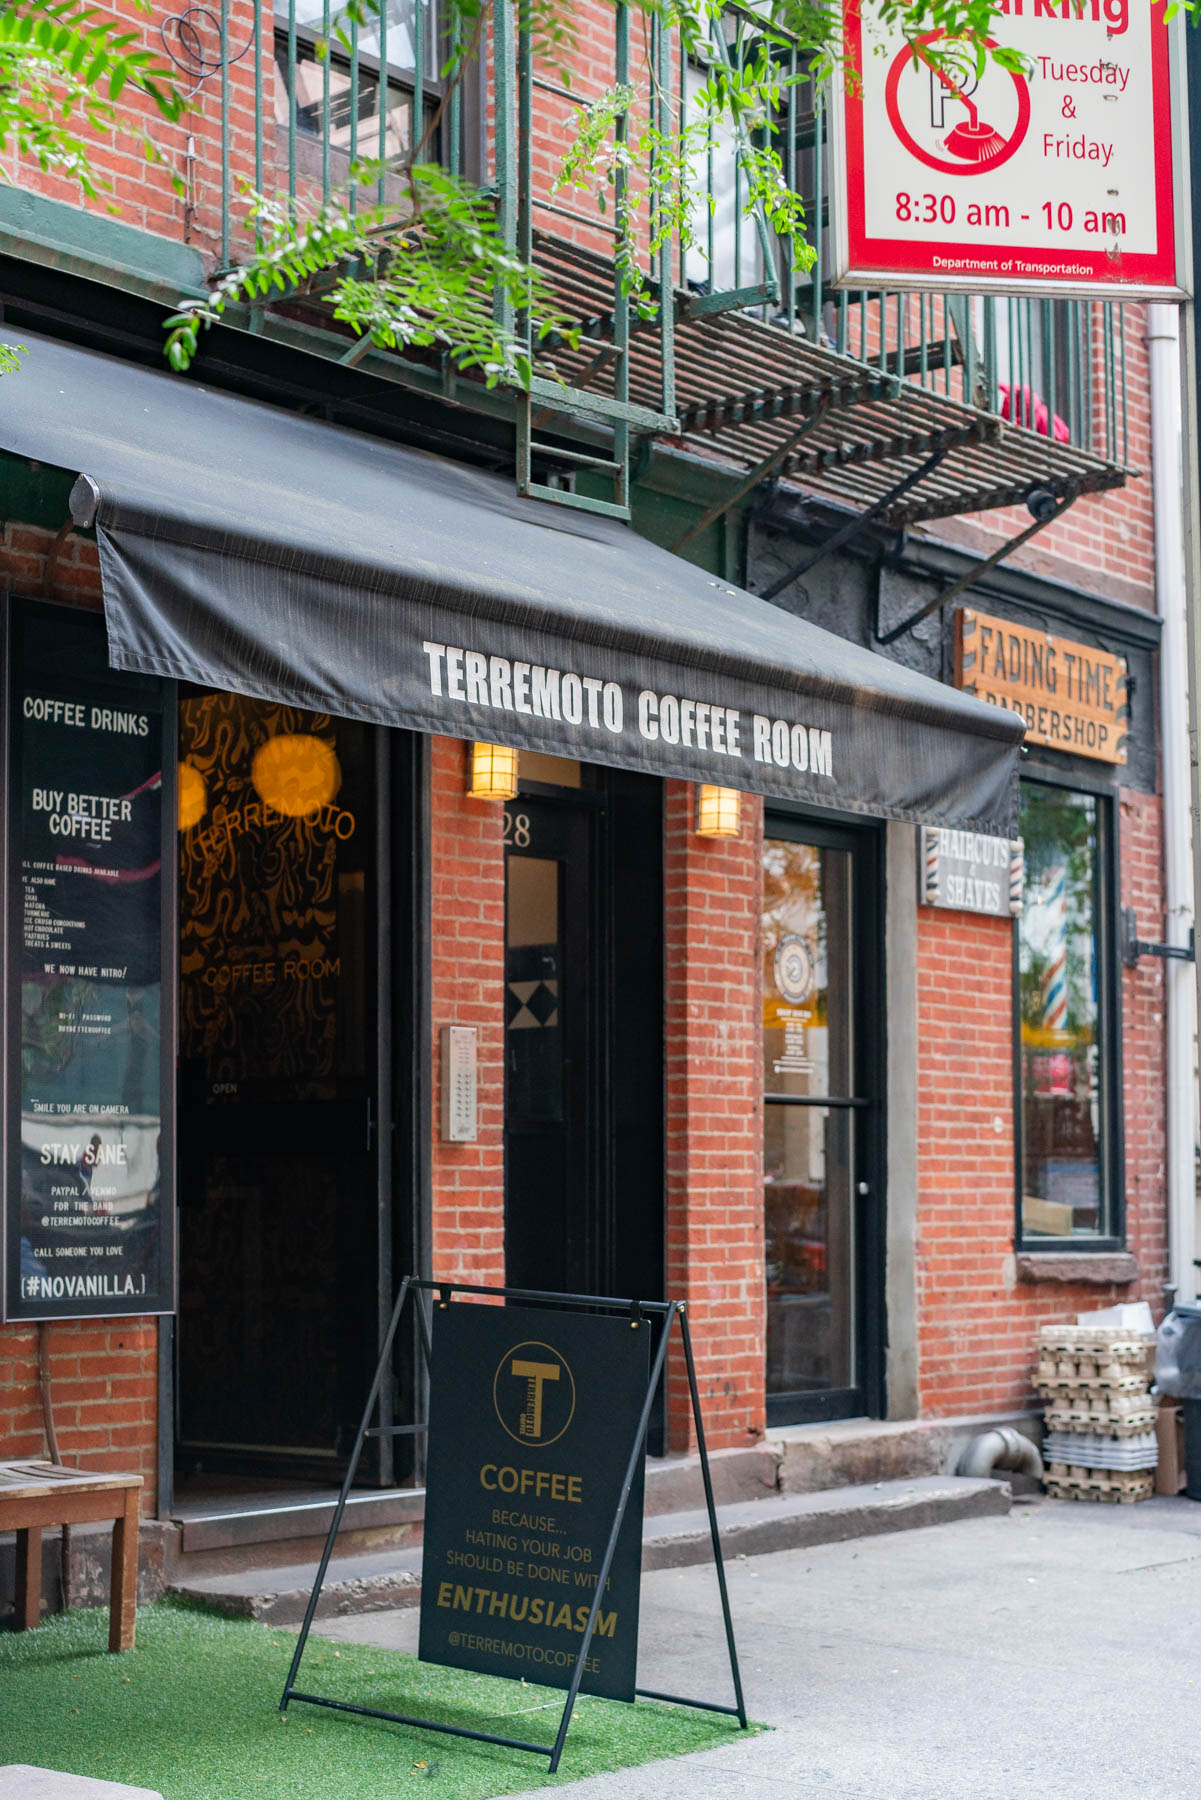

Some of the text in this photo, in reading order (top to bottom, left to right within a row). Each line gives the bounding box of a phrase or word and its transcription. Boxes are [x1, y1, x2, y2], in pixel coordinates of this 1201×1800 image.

[1037, 56, 1130, 91] Tuesday
[1061, 95, 1076, 118] &
[1043, 134, 1114, 167] Friday
[895, 192, 956, 224] 8:30
[967, 203, 1010, 228] am
[1042, 201, 1073, 231] 10
[1084, 209, 1126, 234] am
[932, 256, 1093, 275] Department of Transportation
[980, 625, 1114, 711] FADING TIME
[23, 696, 149, 737] COFFEE DRINKS
[423, 641, 833, 777] TERREMOTO COFFEE ROOM
[32, 788, 132, 822] BUY BETTER
[49, 813, 112, 841] COFFEE
[940, 828, 1009, 869] HAIRCUTS
[33, 862, 54, 871] COFFEE
[55, 863, 72, 873] BASED
[25, 886, 35, 894] TEA
[946, 875, 1000, 912] SHAVES
[44, 963, 127, 979] WE NOW HAVE NITRO!
[206, 958, 340, 987] COFFEE ROOM
[33, 1103, 129, 1114] SMILE YOU ARE ON CAMERA
[40, 1143, 127, 1165] STAY SANE
[51, 1186, 79, 1196] PAYPAL
[90, 1186, 117, 1196] VENMO
[54, 1202, 113, 1211] FOR THE BAND
[41, 1216, 120, 1227] @TERREMOTOCOFFEE
[34, 1246, 123, 1257] CALL SOMEONE YOU LOVE
[480, 1464, 583, 1503] COFFEE
[492, 1509, 567, 1535] BECAUSE...
[465, 1529, 592, 1563] HATING YOUR JOB
[446, 1550, 503, 1573] SHOULD
[507, 1560, 524, 1576] BE
[528, 1563, 570, 1585] DONE
[437, 1582, 617, 1638] ENTHUSIASM
[448, 1631, 600, 1674] @TERREMOTOCOFEE
